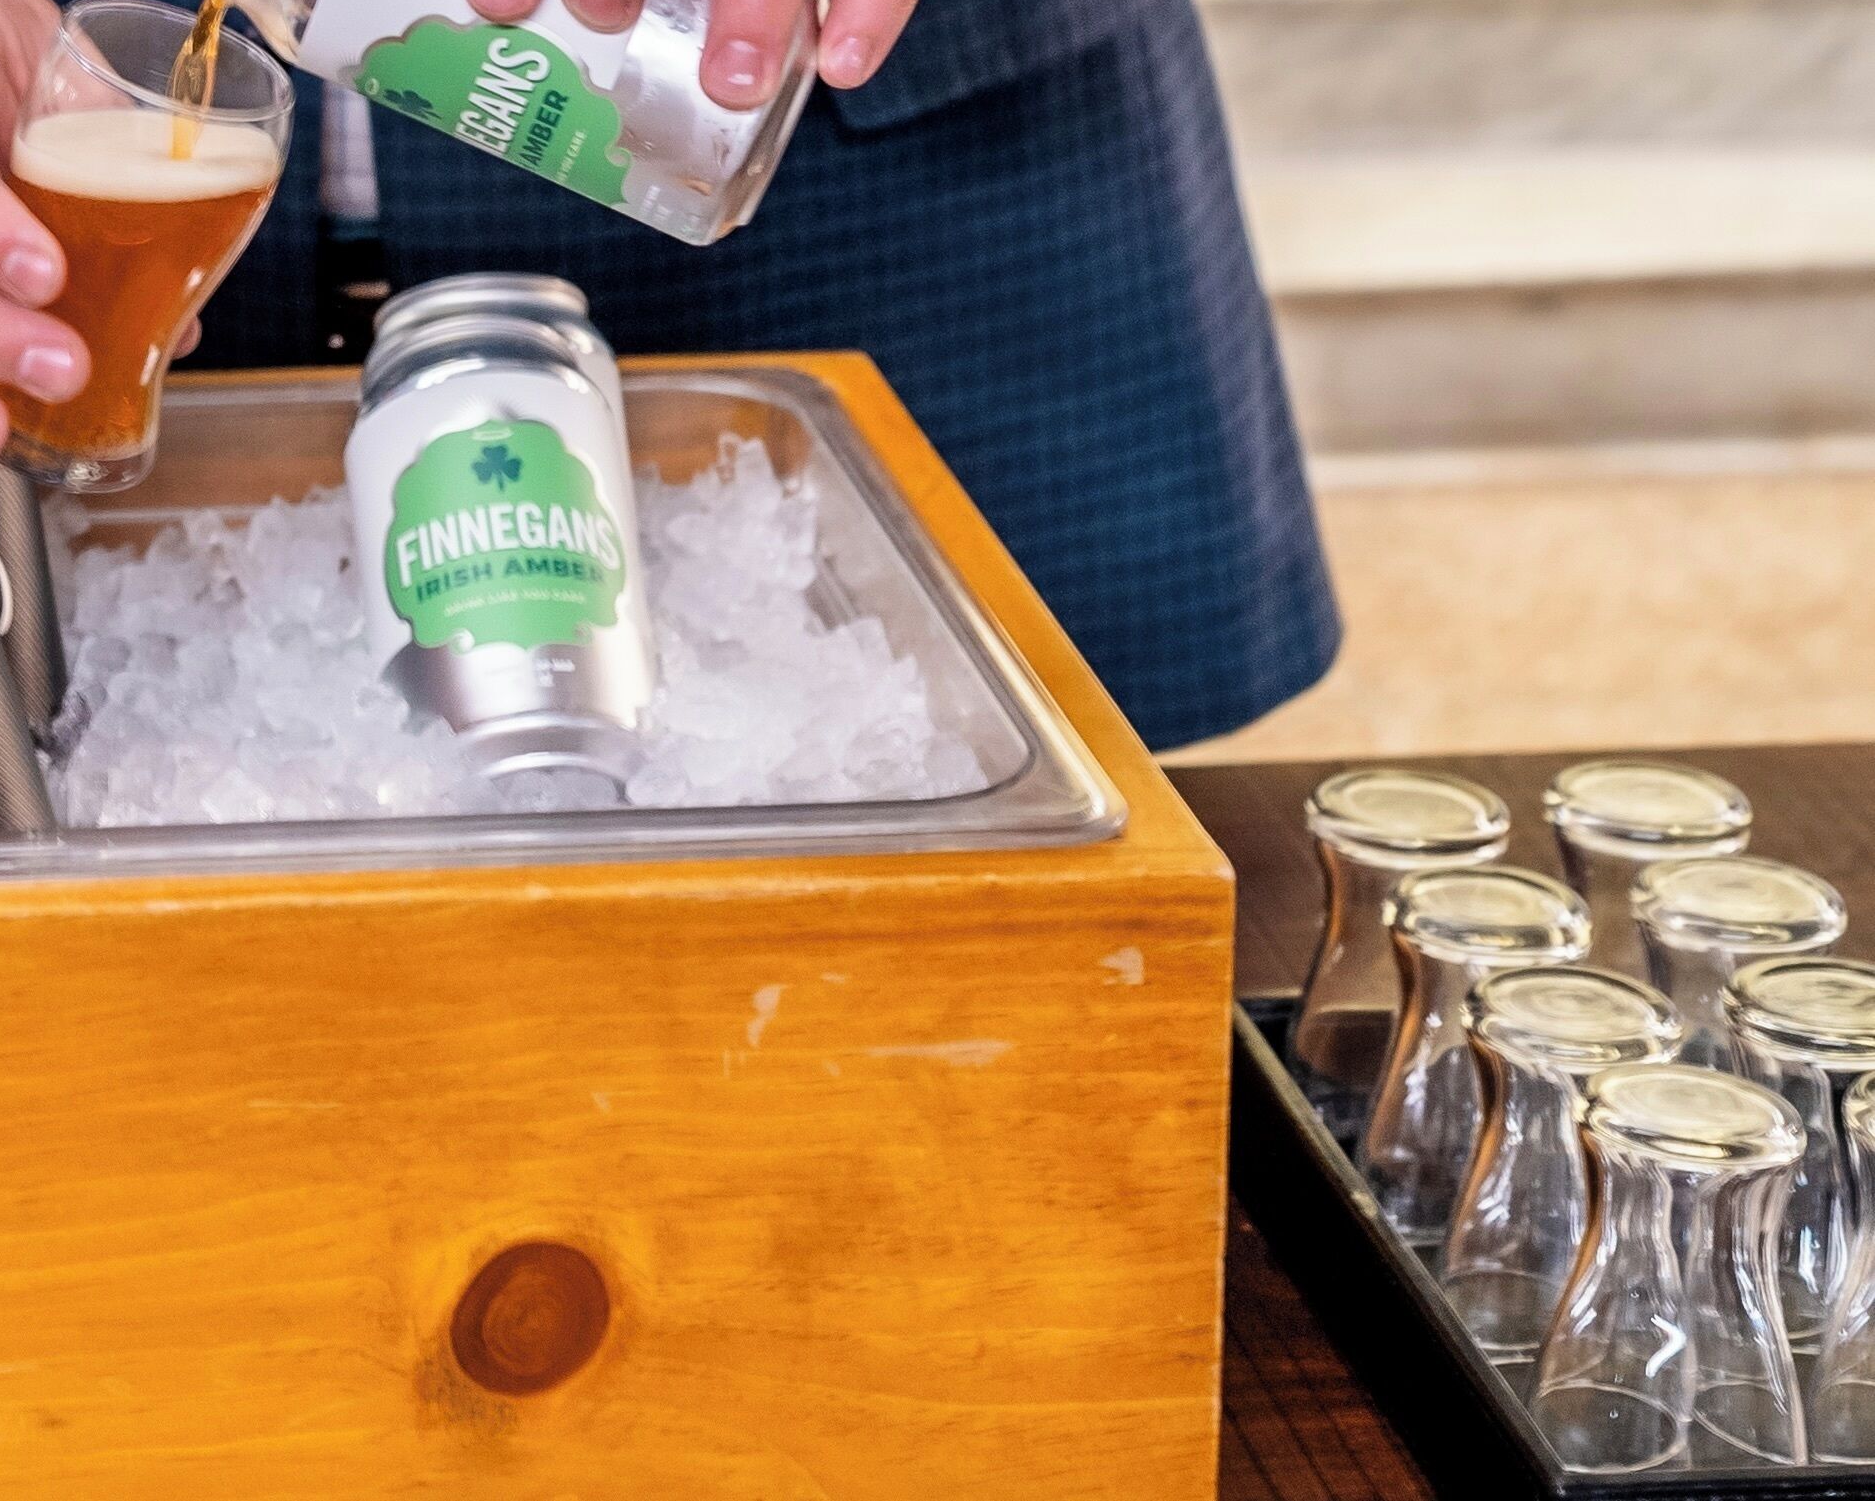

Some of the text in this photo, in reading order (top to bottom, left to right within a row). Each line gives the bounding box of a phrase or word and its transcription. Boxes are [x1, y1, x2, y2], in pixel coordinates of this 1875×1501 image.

[519, 89, 569, 167] AMBER
[396, 501, 621, 588] FINNEGANS
[416, 563, 493, 602] IRISH
